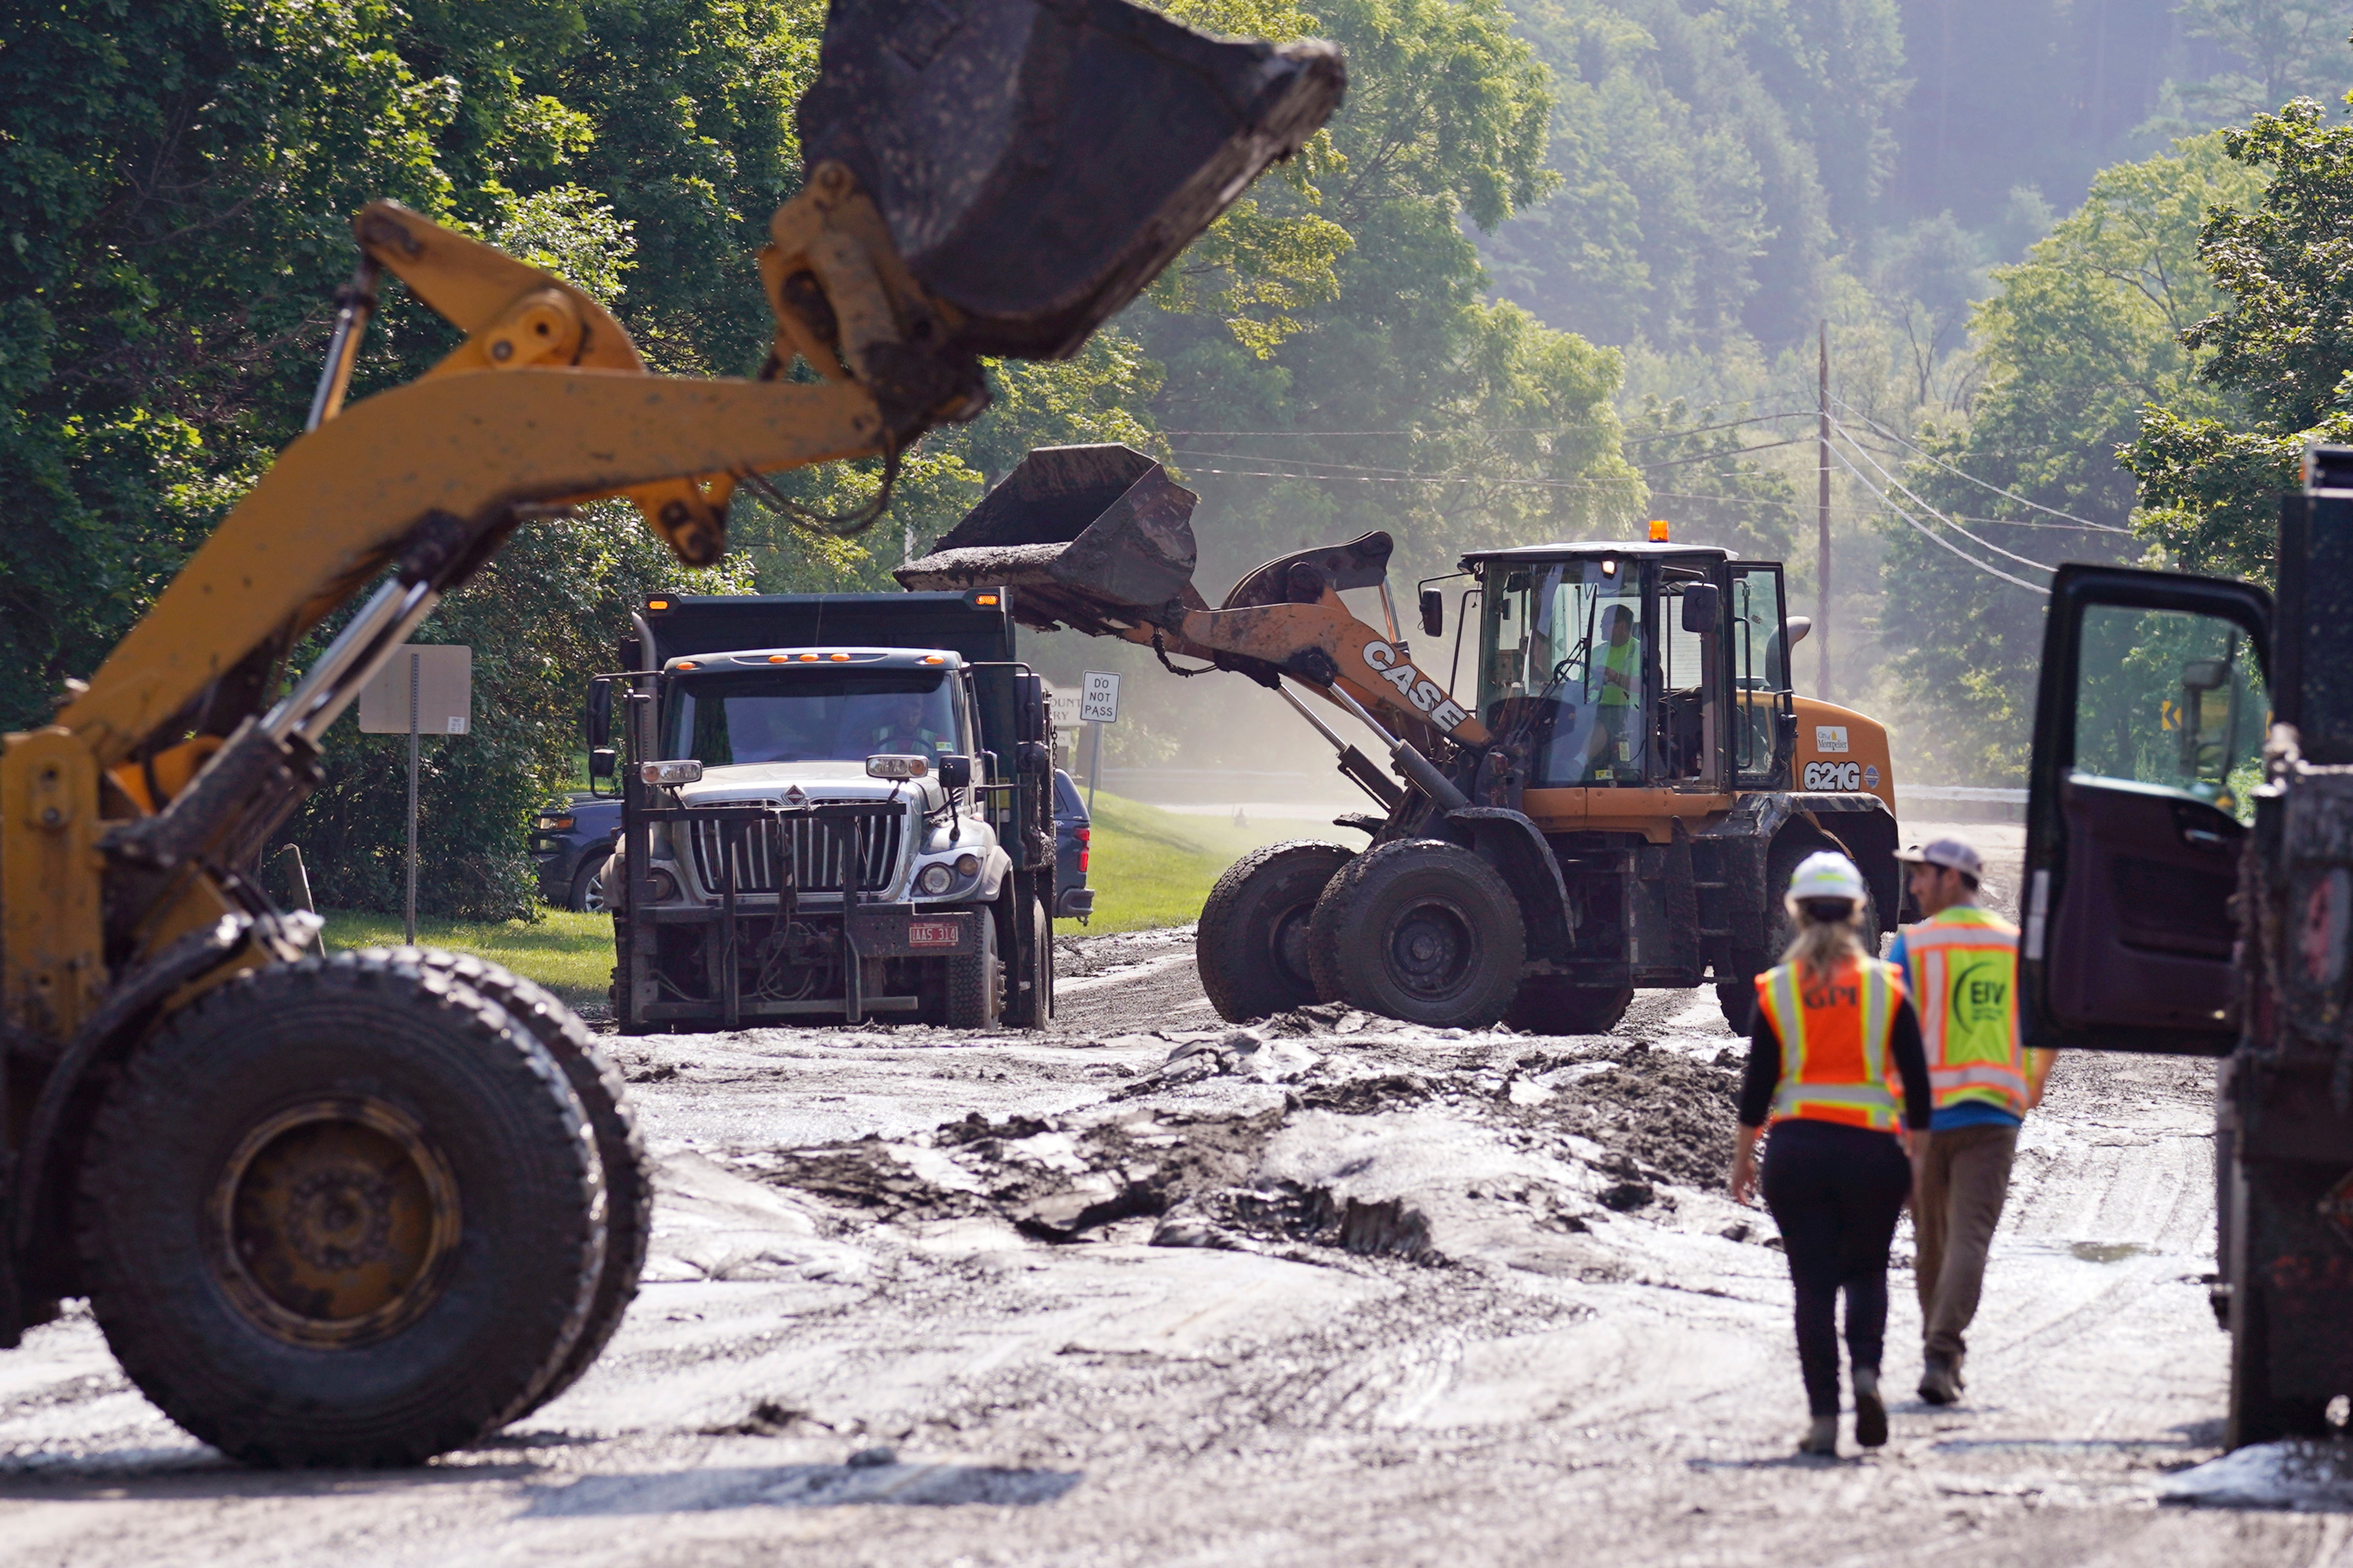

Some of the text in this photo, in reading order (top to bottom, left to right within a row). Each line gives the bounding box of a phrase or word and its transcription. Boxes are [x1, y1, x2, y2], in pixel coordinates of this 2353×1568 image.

[1095, 678, 1109, 688] DO
[1362, 640, 1469, 733] CASE
[1050, 698, 1081, 707] OUNT
[1090, 692, 1111, 702] NOT
[1085, 705, 1113, 717] PASS
[1803, 761, 1861, 791] 621G
[938, 928, 955, 940] 314
